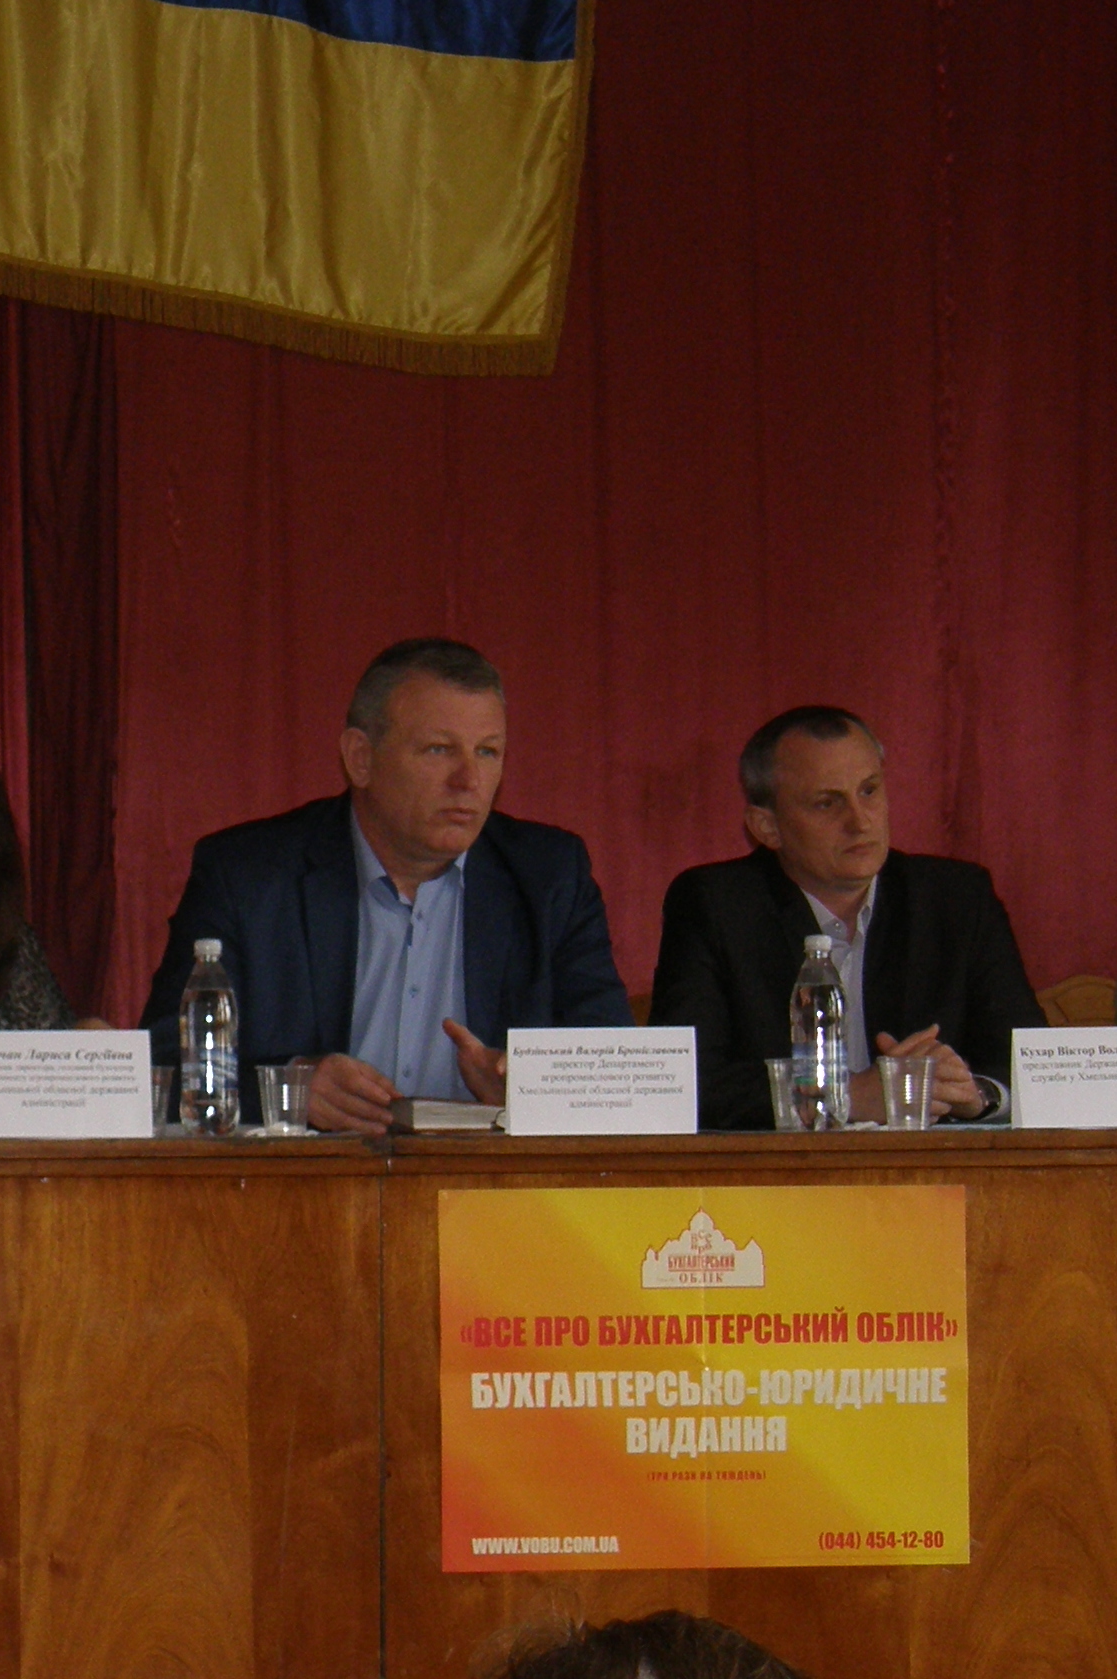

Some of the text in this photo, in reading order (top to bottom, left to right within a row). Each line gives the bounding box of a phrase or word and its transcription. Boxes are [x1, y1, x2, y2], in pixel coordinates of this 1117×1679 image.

[1020, 1047, 1054, 1059] Кухар
[1057, 1046, 1095, 1058] Віктор
[679, 1272, 724, 1284] ОБЛІК
[460, 1306, 958, 1348] «ВСЕ ПРО БУХГАЛТЕРСЬКИЙ ОБЛІК»
[471, 1367, 947, 1409] БУХГАЛТЕРСЬКО-ЮРИДИЧНЕ
[626, 1416, 787, 1459] ВИДАННЯ
[472, 1536, 619, 1555] WWW.VOBU.COM.UA
[818, 1530, 944, 1550] (044) 454-12-80
